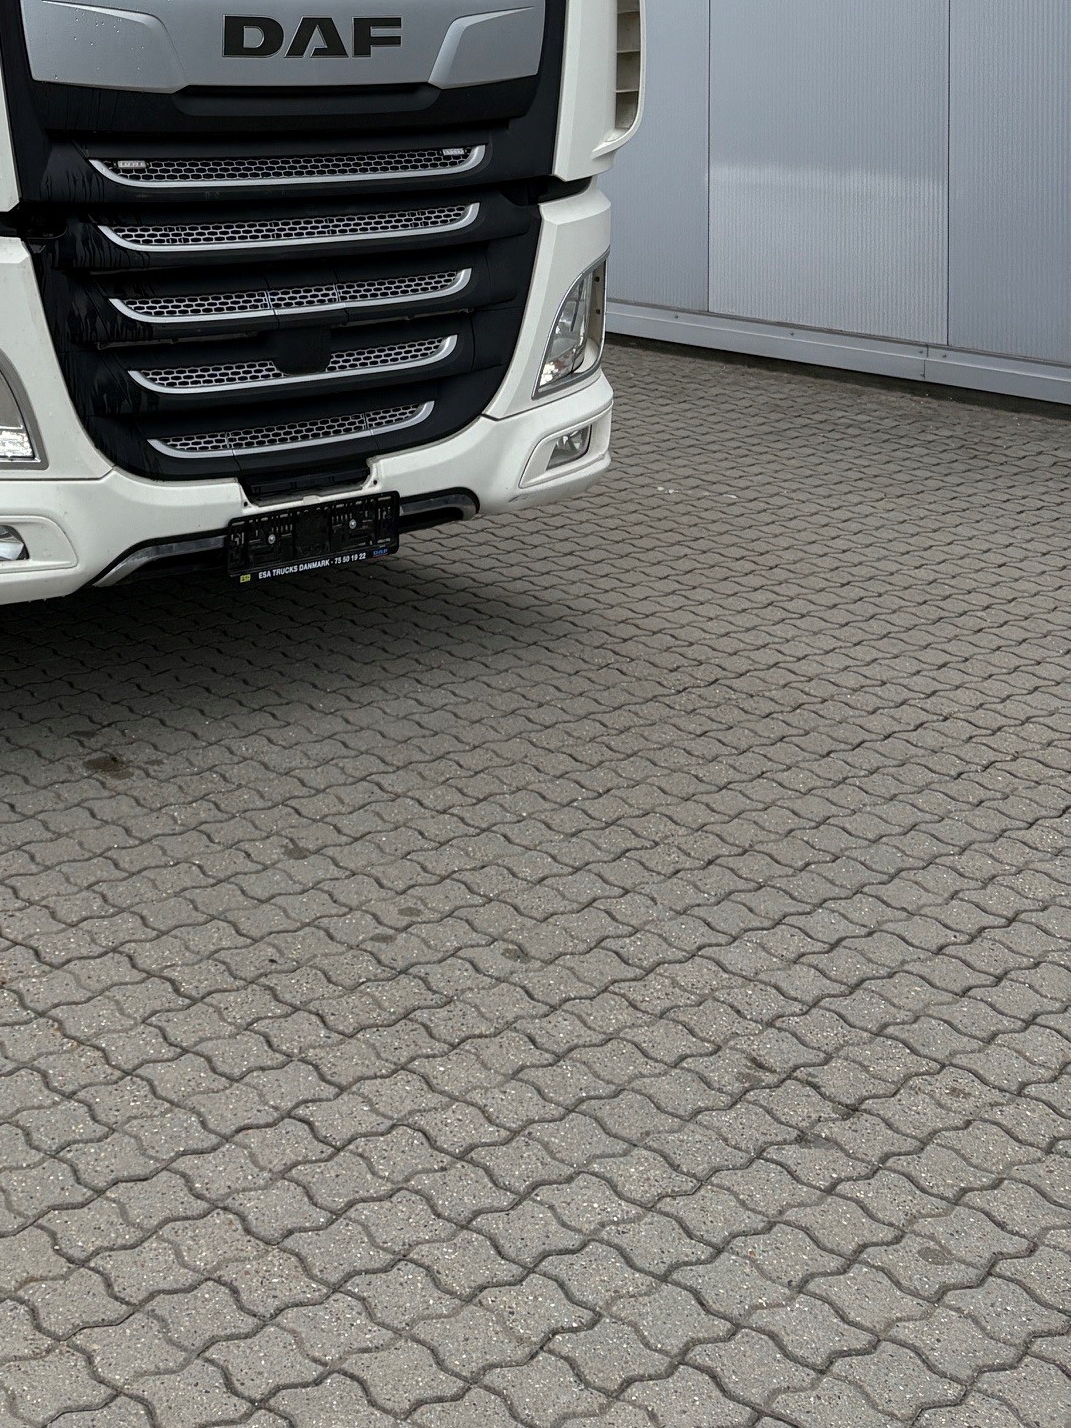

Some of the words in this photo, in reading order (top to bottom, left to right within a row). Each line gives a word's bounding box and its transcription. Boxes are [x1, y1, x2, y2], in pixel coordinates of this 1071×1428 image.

[222, 14, 403, 59] DAF
[258, 571, 272, 580] ESA
[272, 565, 299, 577] TRUCKS
[298, 558, 330, 572] DANMARK
[359, 552, 367, 560] 22
